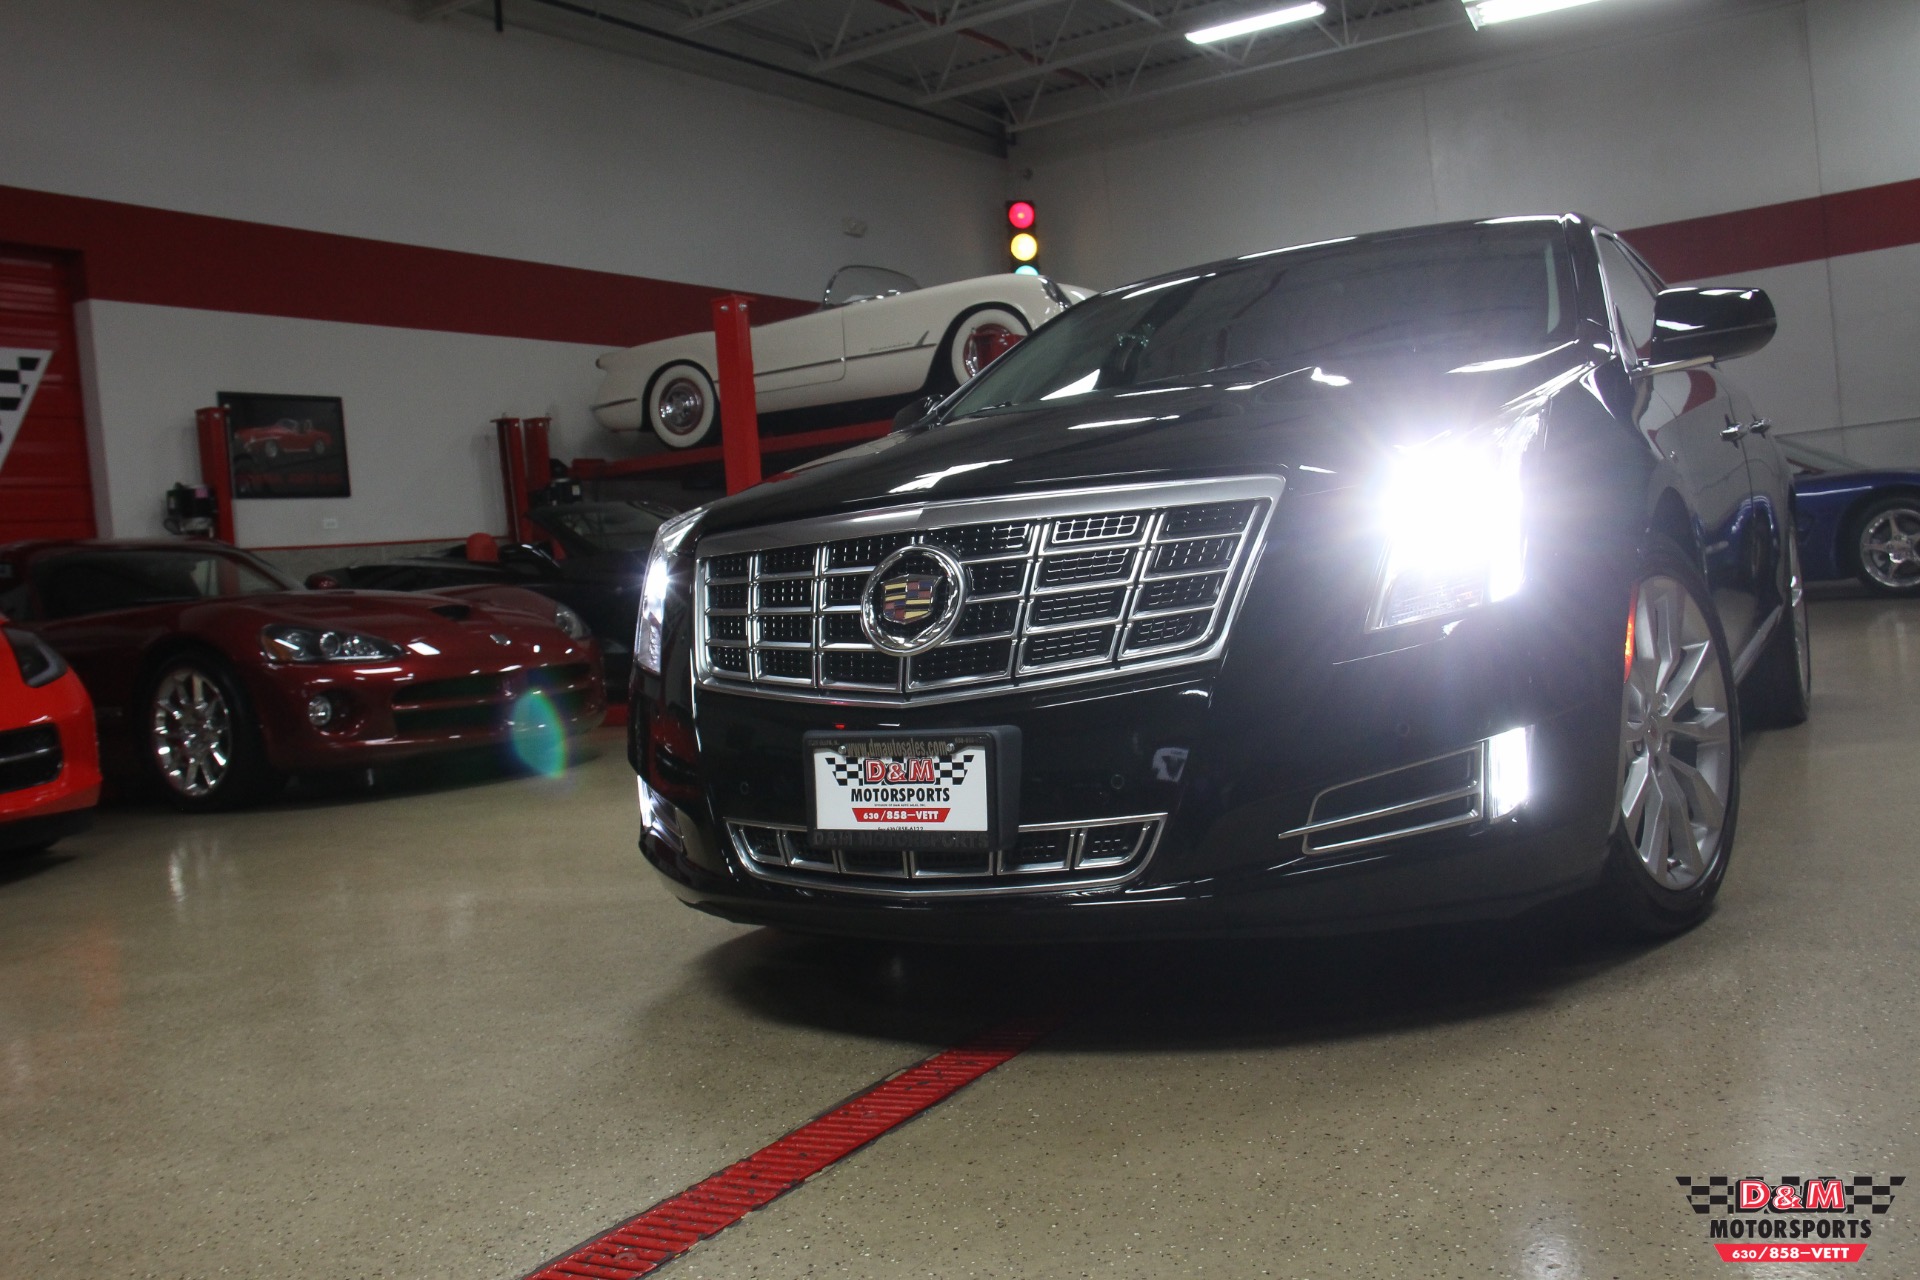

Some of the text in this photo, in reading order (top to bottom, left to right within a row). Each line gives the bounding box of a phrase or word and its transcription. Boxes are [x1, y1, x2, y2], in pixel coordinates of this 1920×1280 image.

[847, 738, 948, 757] www.dmautosales.com
[865, 758, 936, 784] D&M
[851, 788, 950, 802] MOTORSPORTS
